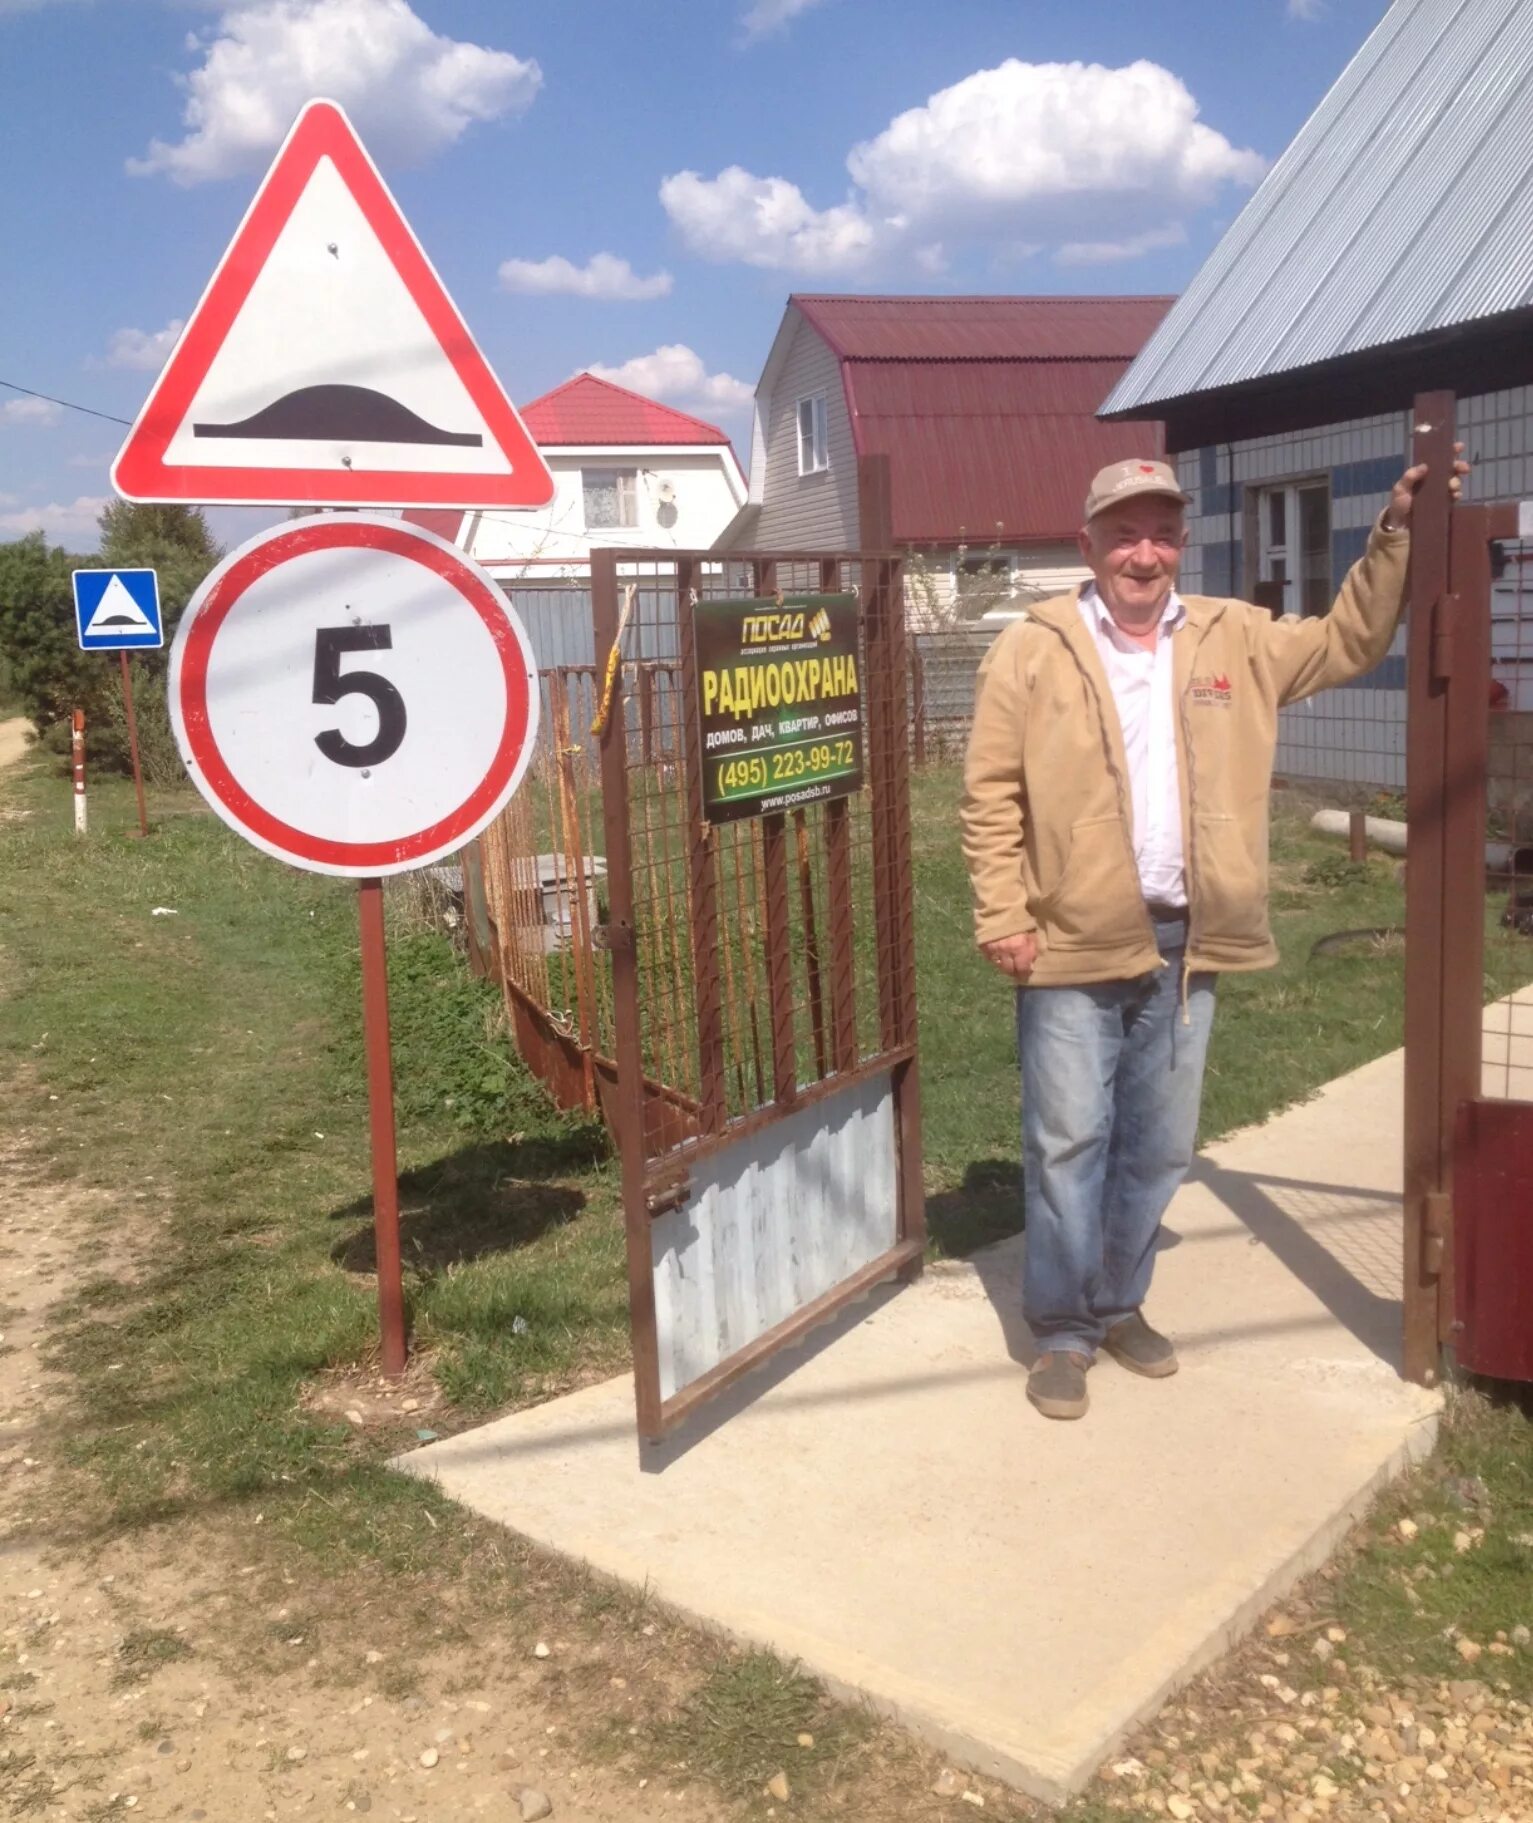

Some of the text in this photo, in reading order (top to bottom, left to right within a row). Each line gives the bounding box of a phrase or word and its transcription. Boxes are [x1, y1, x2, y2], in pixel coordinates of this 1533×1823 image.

[742, 613, 805, 643] ПОСАД
[312, 624, 407, 768] 5
[703, 655, 858, 720] РАДИООХРАНА
[706, 709, 858, 749] ДОМОВ, ДАЧ, КВАРТИР, ОФИСОВ
[718, 740, 854, 796] (495) 223-99-72
[761, 785, 831, 809] www.posadsb.ru
